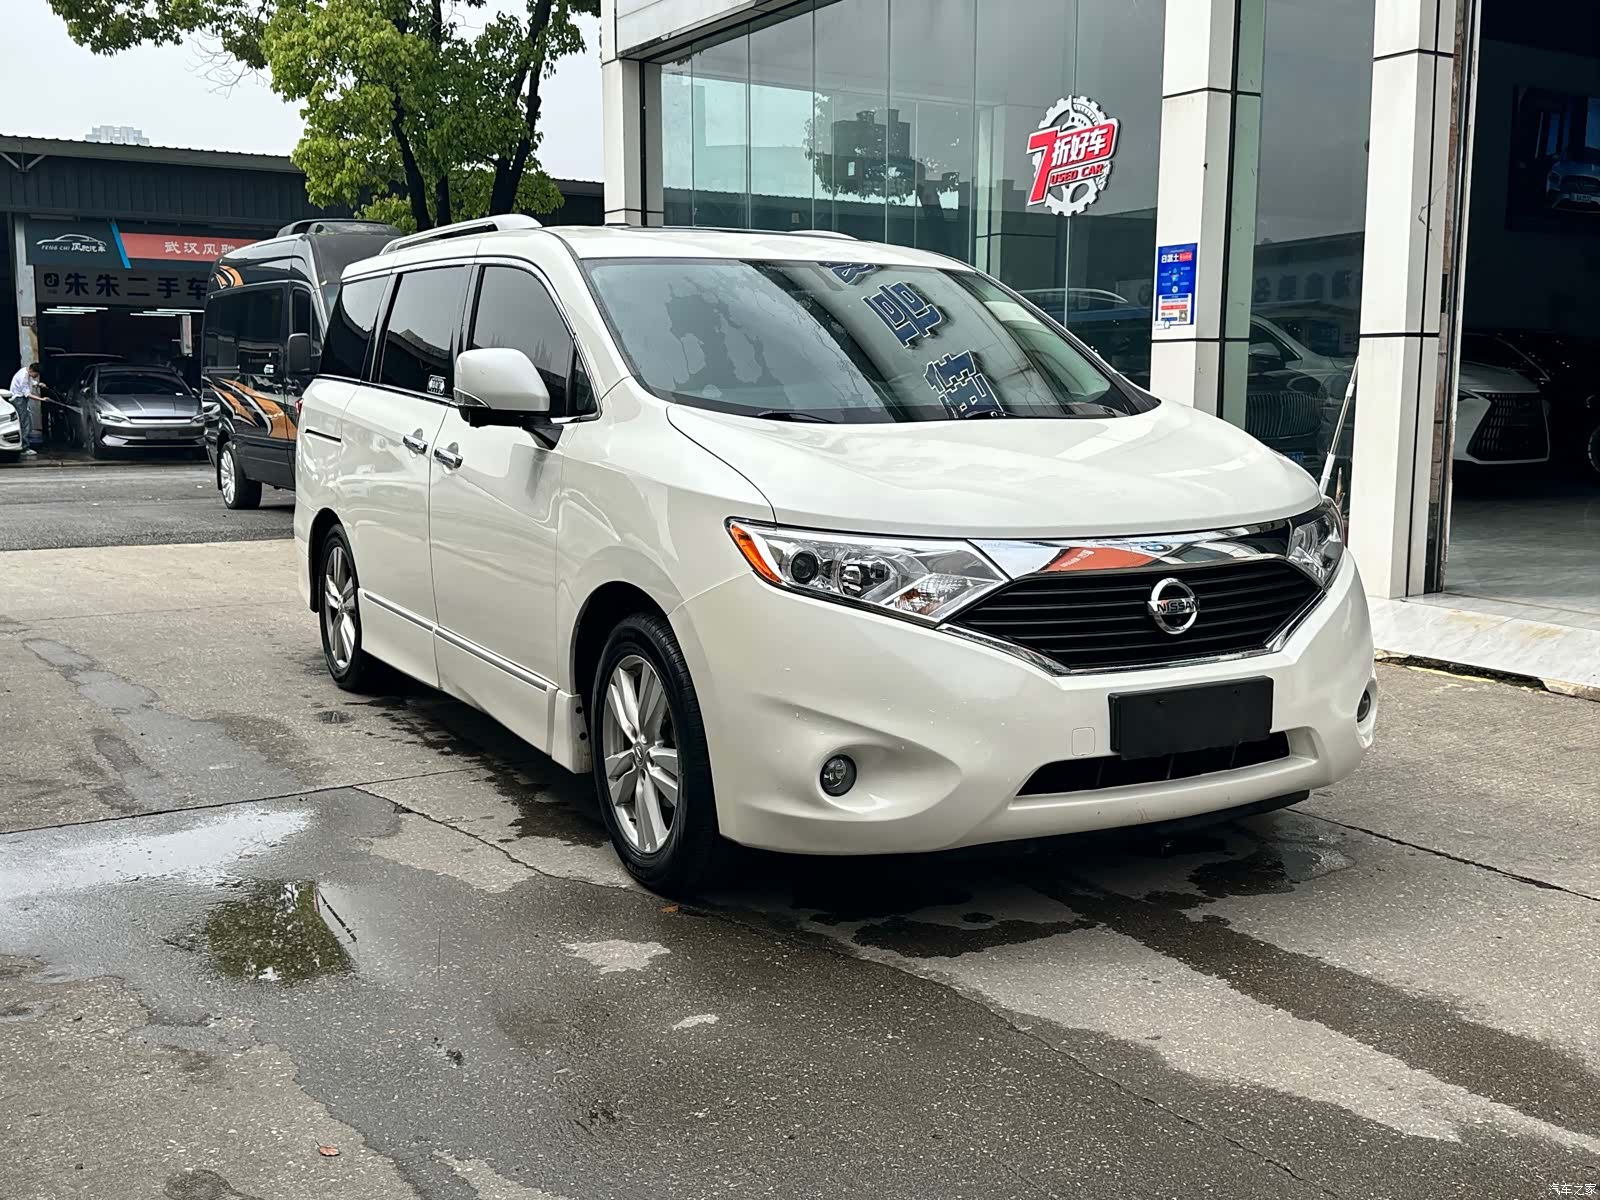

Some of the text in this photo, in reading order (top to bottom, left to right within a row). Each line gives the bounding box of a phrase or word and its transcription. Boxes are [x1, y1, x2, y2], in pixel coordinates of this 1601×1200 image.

[1050, 163, 1105, 184] USED CAR
[64, 272, 209, 301] 朱朱二手车
[1156, 599, 1199, 613] NISSAN
